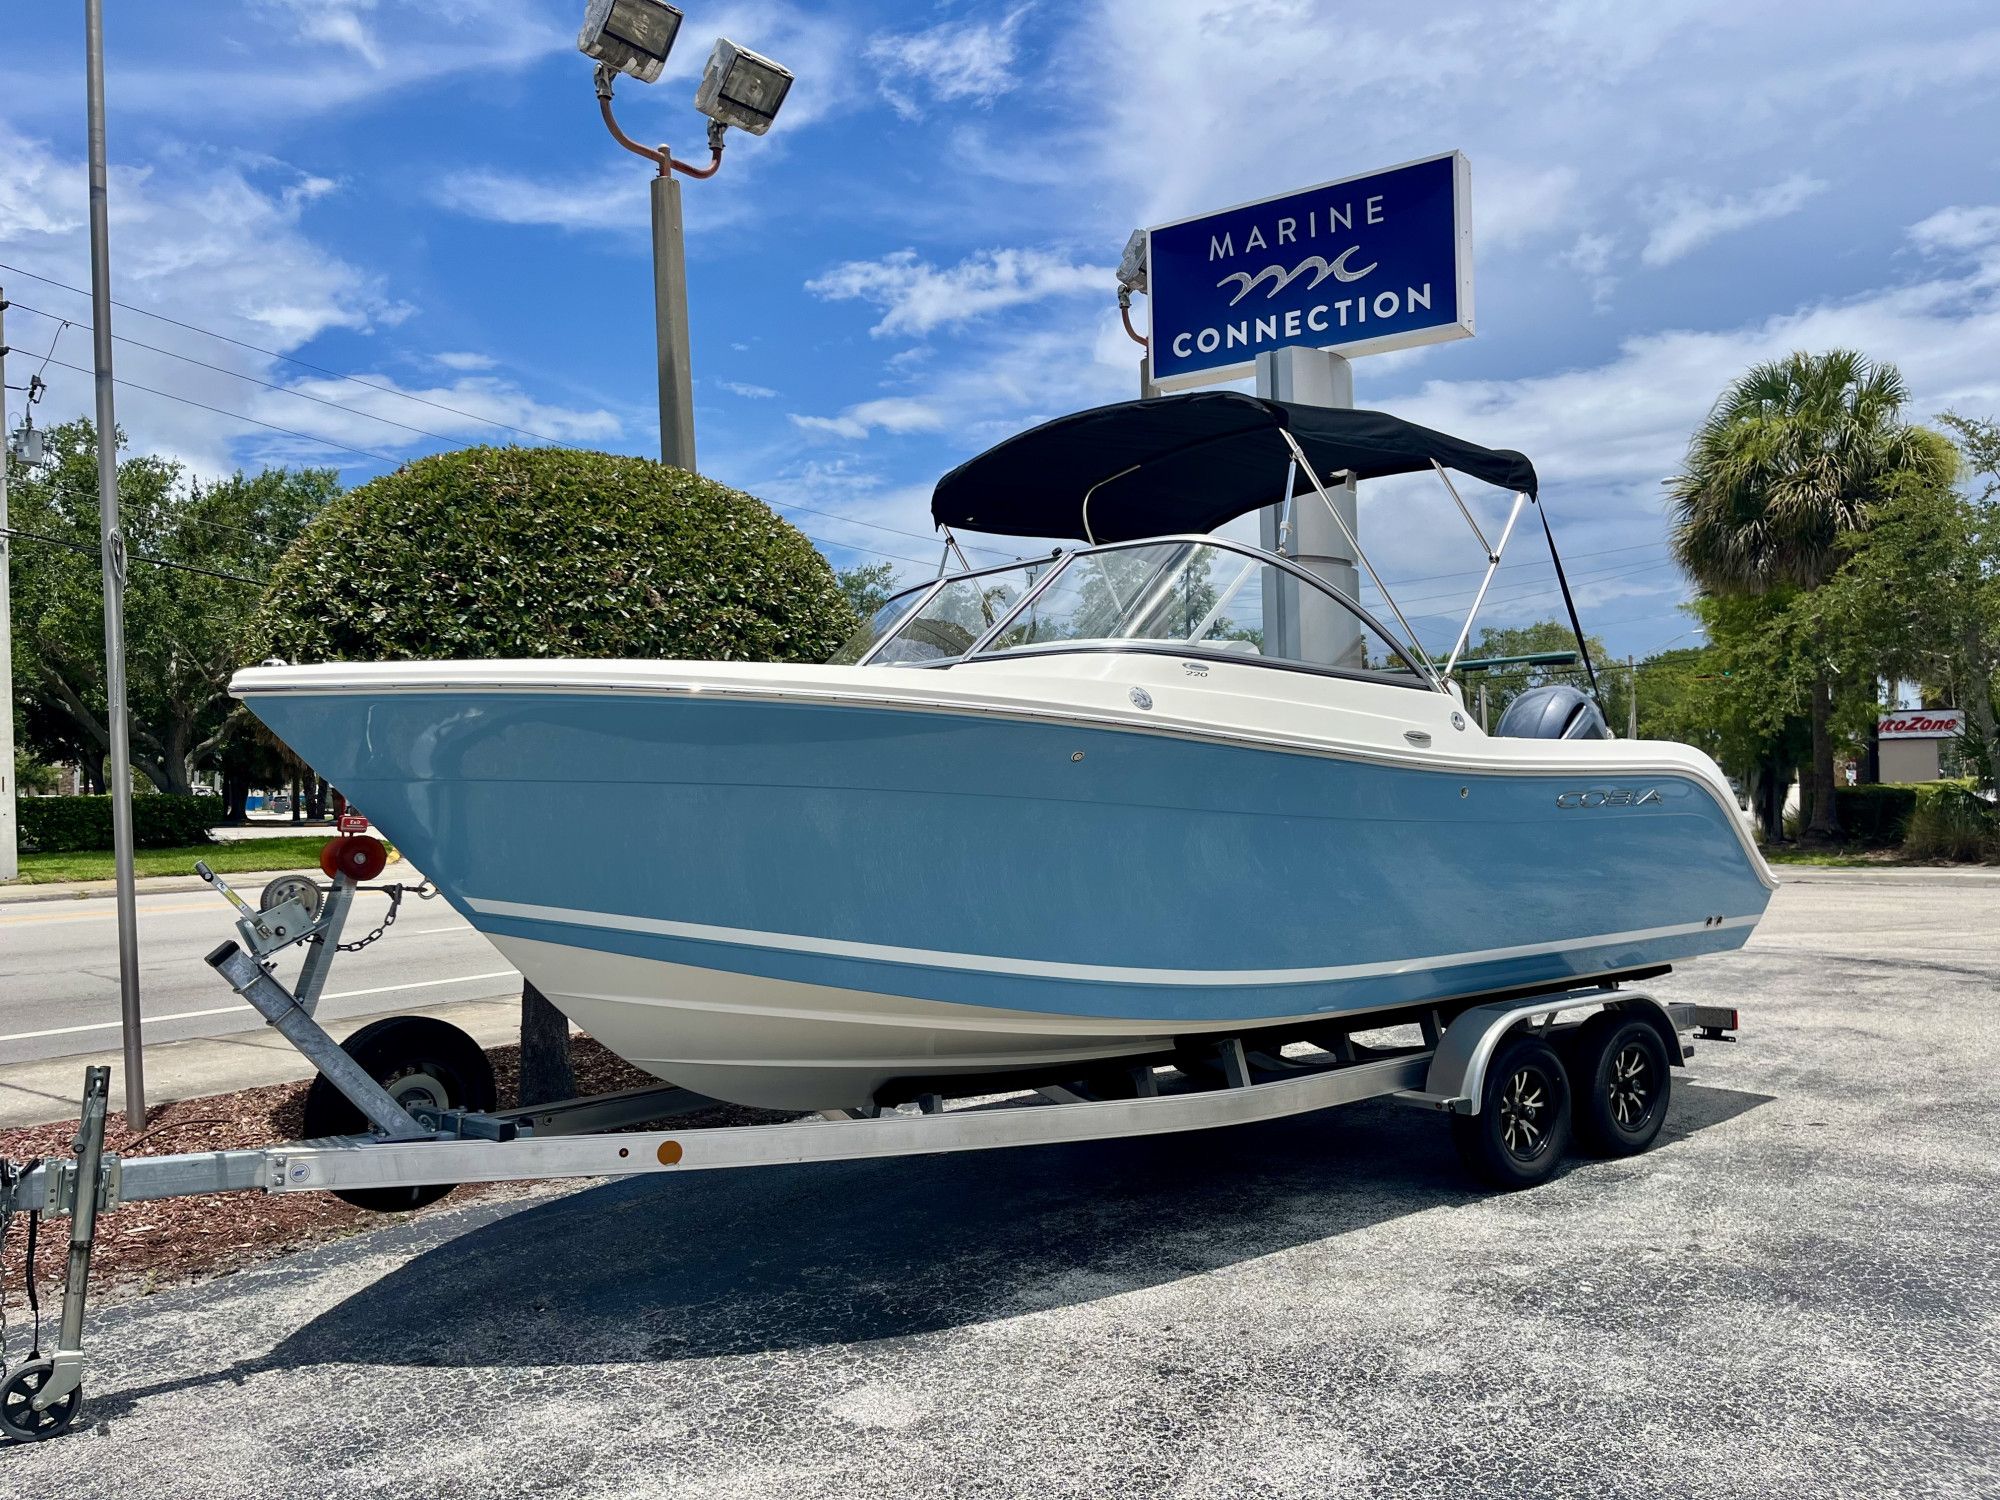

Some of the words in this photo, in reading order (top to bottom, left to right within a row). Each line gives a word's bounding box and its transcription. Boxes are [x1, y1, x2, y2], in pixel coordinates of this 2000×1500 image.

[1209, 195, 1384, 261] MARINE
[1172, 283, 1431, 357] CONNECTION
[1878, 716, 1957, 732] utoZone
[1556, 789, 1663, 809] COBIA
